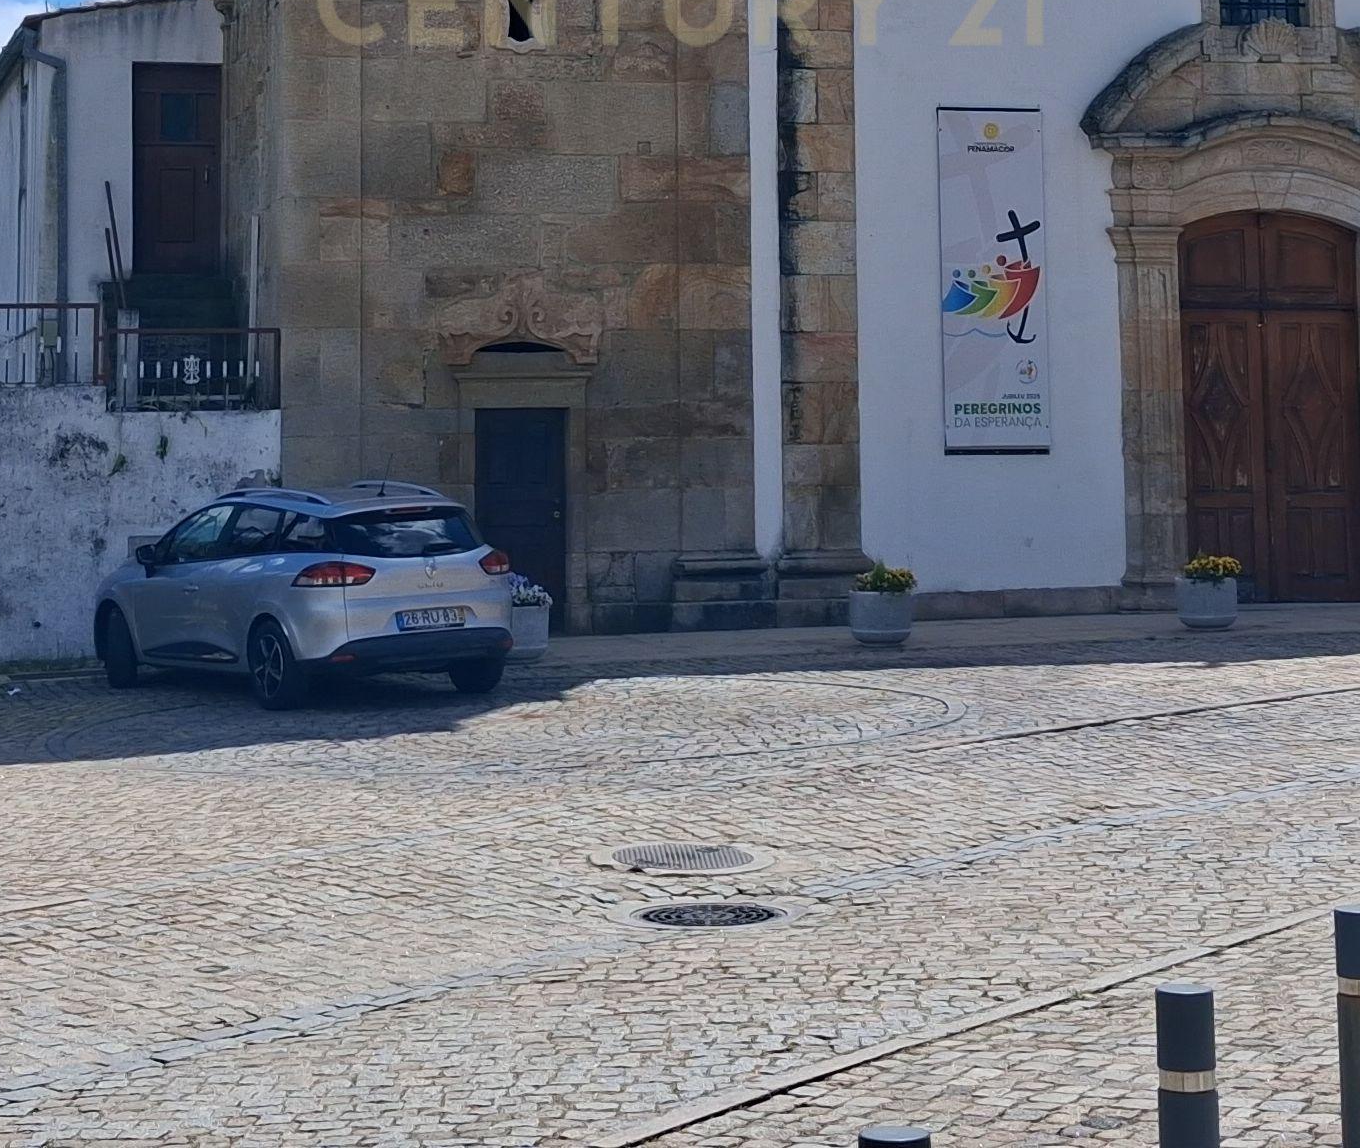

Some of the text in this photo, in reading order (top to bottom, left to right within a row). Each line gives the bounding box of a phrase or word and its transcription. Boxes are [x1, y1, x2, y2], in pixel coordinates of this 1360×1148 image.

[954, 403, 1042, 415] PEREGRINOS
[954, 416, 1042, 430] DA ESPERANÇA
